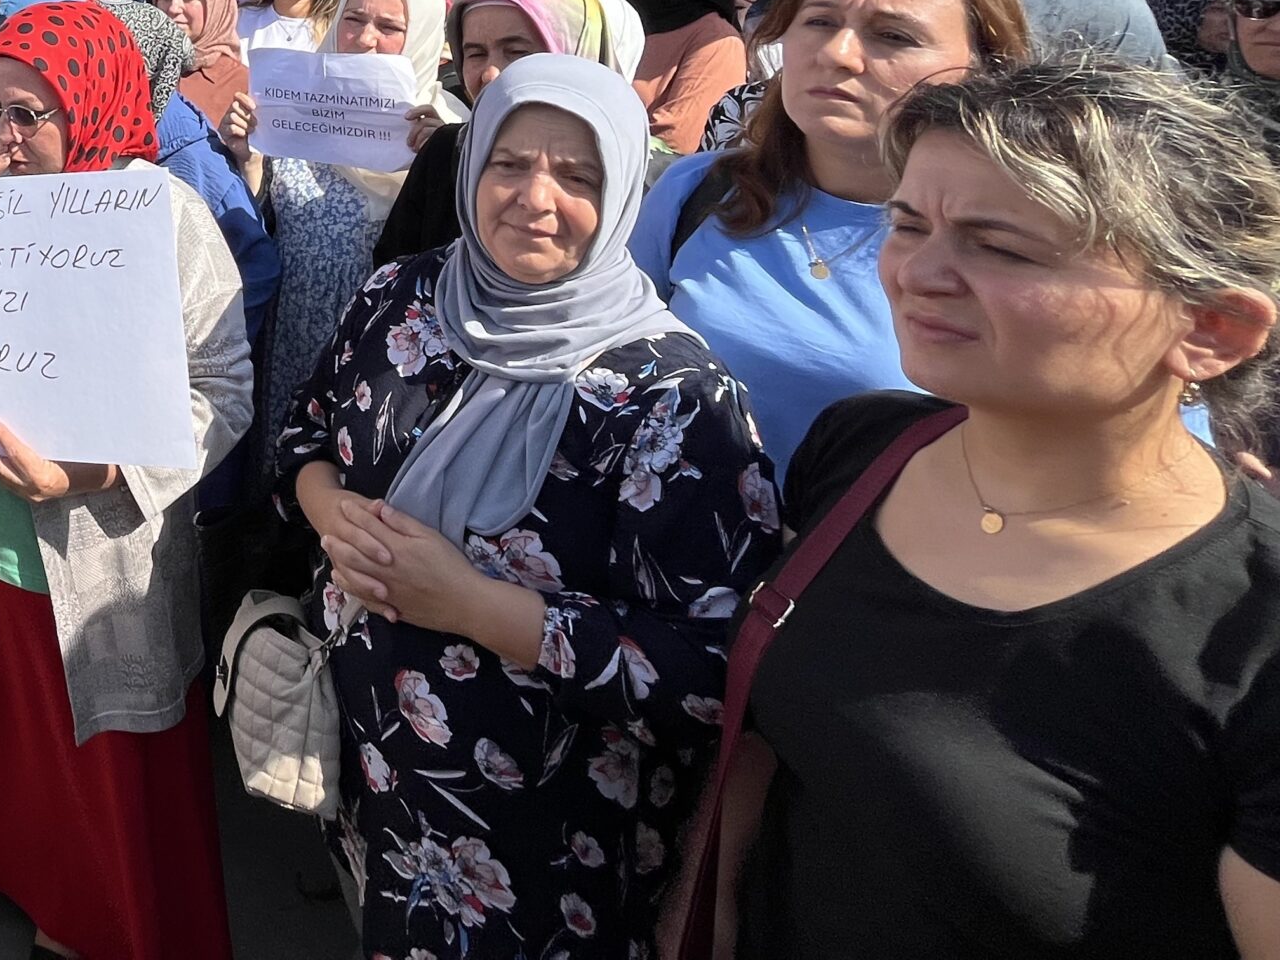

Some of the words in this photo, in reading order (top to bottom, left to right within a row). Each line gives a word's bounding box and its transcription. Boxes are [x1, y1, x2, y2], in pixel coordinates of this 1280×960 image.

[264, 87, 301, 101] KIDEM
[303, 92, 396, 109] TAZMİNATIMIZI
[311, 108, 346, 120] BİZİM
[271, 118, 376, 140] GELECEĞİMİZDİR
[378, 130, 392, 141] !!!
[49, 182, 163, 219] YILLARIN
